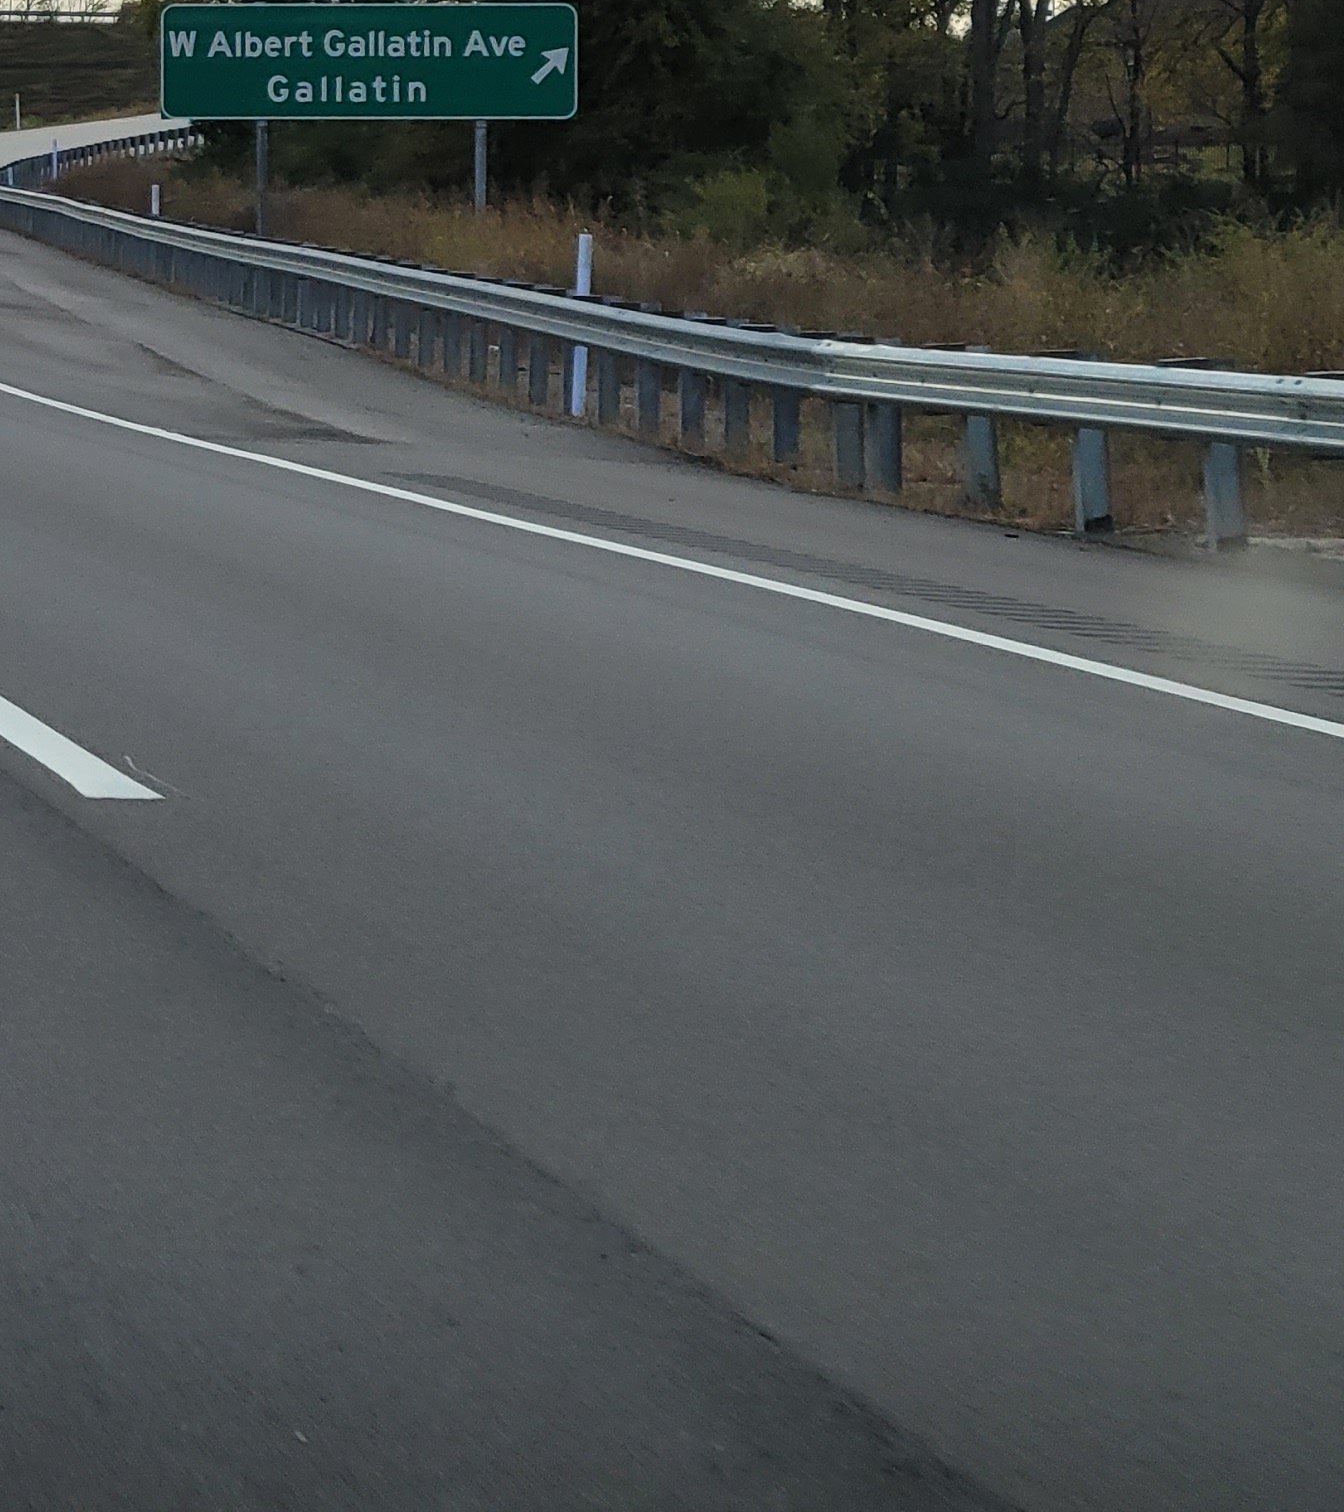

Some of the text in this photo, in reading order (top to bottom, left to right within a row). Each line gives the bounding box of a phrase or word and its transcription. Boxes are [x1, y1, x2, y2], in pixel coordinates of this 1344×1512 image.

[169, 29, 526, 58] W Albert Gallatin Ave
[267, 74, 427, 103] Gallatin
